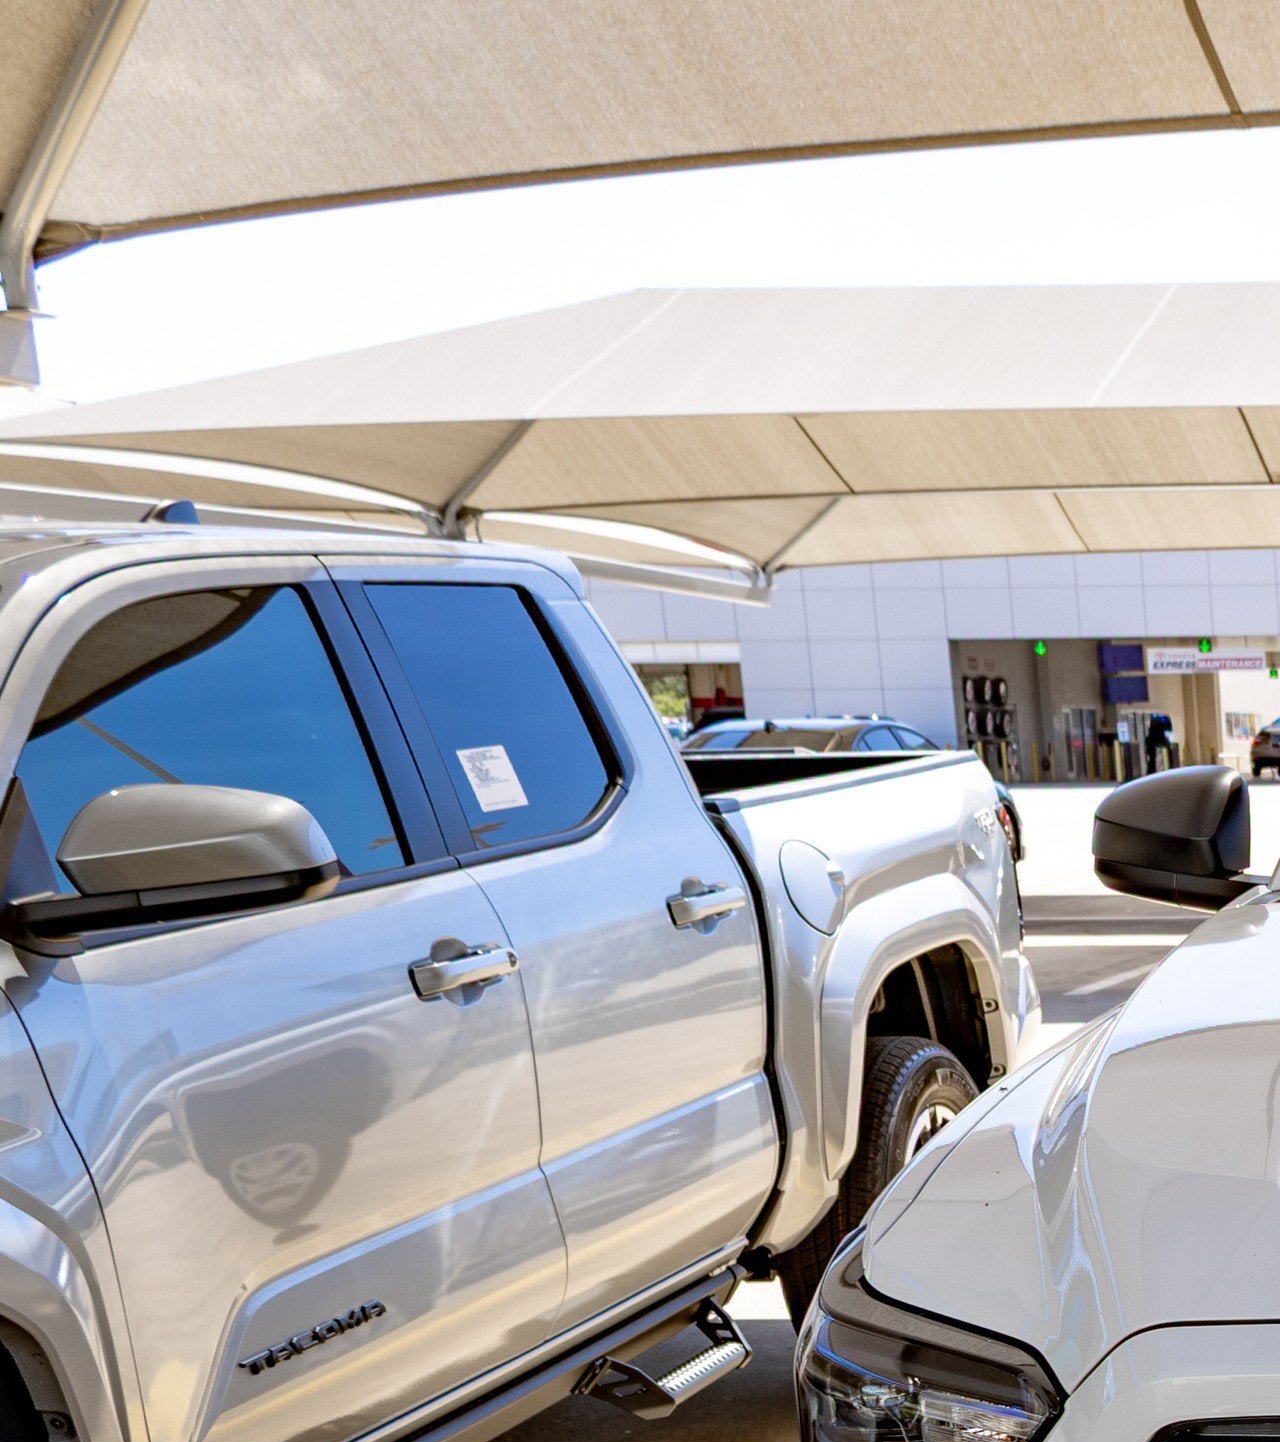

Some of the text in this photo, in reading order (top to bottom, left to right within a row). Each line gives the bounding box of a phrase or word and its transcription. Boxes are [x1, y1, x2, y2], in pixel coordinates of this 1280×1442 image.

[1153, 660, 1263, 669] EXPRESS MAINTENANCE
[238, 1300, 387, 1375] TACOMA
